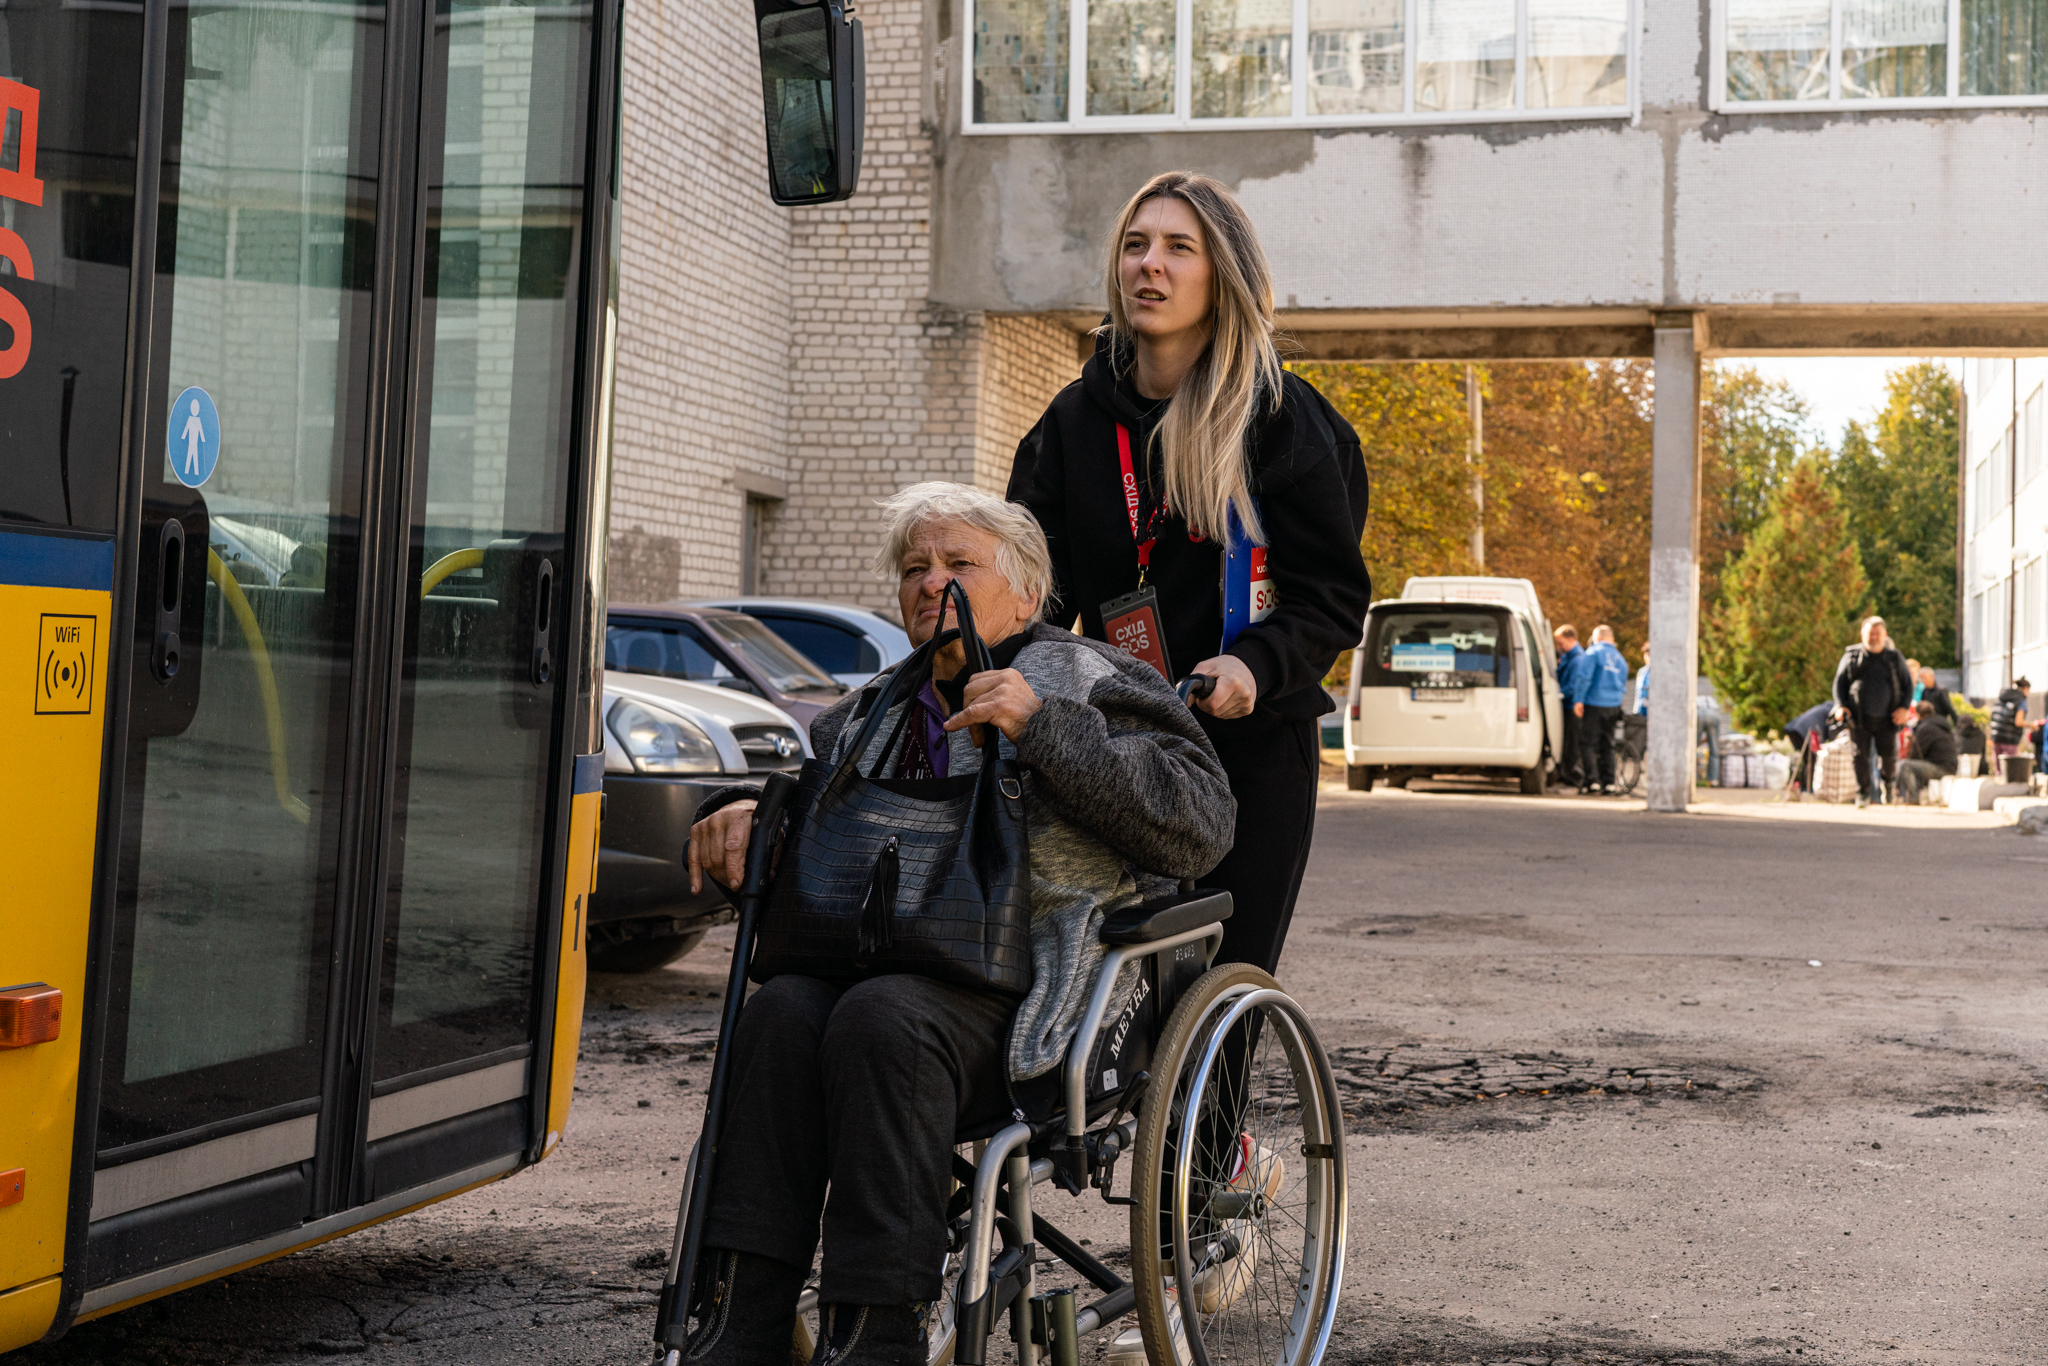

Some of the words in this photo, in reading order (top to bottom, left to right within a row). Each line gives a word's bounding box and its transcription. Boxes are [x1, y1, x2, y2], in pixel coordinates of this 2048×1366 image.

[1123, 472, 1139, 508] СХІД
[1256, 588, 1280, 611] SOS
[55, 626, 80, 643] WiFi
[1115, 620, 1147, 641] СХІД
[1119, 634, 1150, 654] SOS
[573, 894, 582, 952] 1
[1110, 978, 1150, 1061] MEYRA
